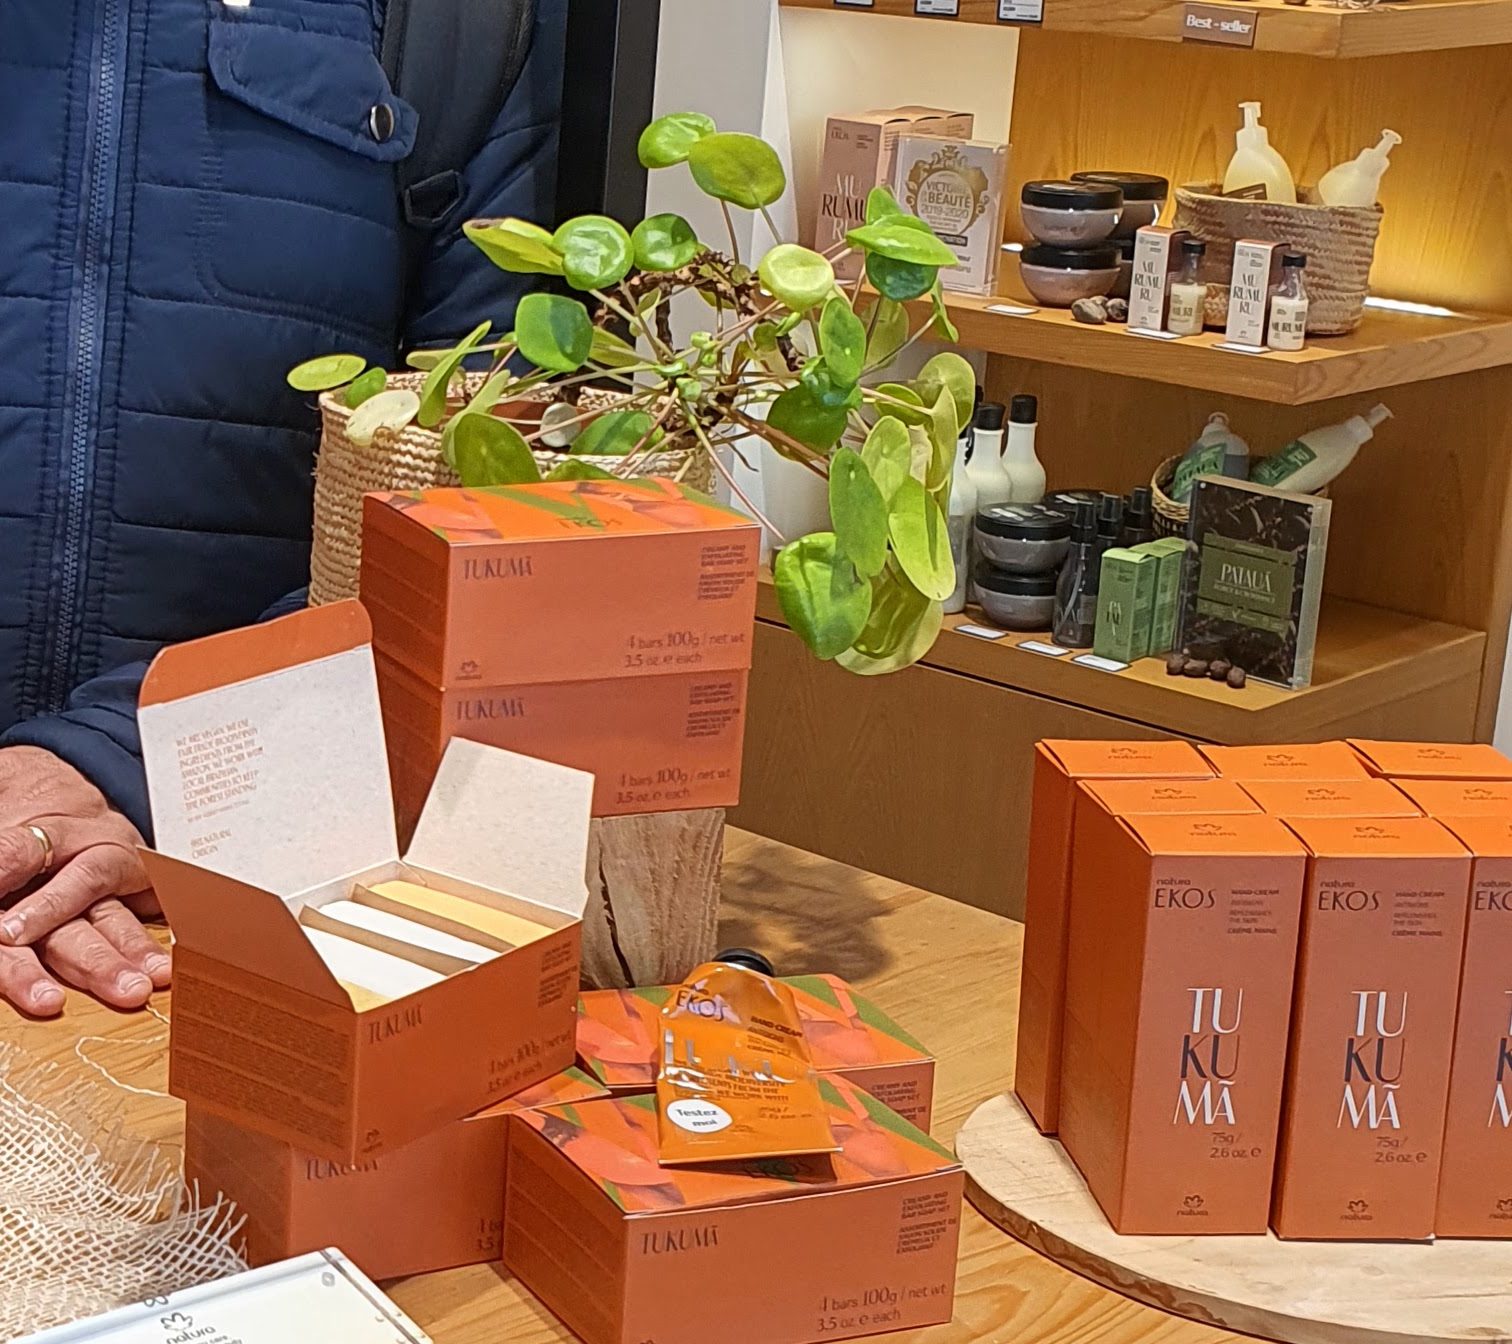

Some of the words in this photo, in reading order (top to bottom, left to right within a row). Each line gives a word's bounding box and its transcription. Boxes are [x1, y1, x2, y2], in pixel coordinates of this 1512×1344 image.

[1187, 14, 1213, 27] Best
[1220, 19, 1251, 33] seller
[464, 556, 533, 580] TUKUMÃ
[667, 631, 699, 648] 100g
[1156, 877, 1191, 886] natura
[1320, 880, 1356, 888] natura
[1154, 887, 1217, 910] EKOS
[1318, 890, 1382, 912] EKOS
[676, 989, 725, 1022] EKOS
[1187, 987, 1244, 1035] TU
[1351, 991, 1408, 1037] TU
[1180, 1034, 1240, 1080] KU
[1344, 1037, 1406, 1083] KU
[675, 1108, 718, 1117] Testez
[1173, 1079, 1236, 1125] MÃ
[1337, 1083, 1401, 1129] MÃ
[641, 1225, 719, 1255] TUKUMÃ
[832, 1298, 858, 1311] bars
[863, 1287, 898, 1307] 100g
[908, 1286, 927, 1299] net
[931, 1283, 947, 1296] wt
[872, 1308, 901, 1324] each
